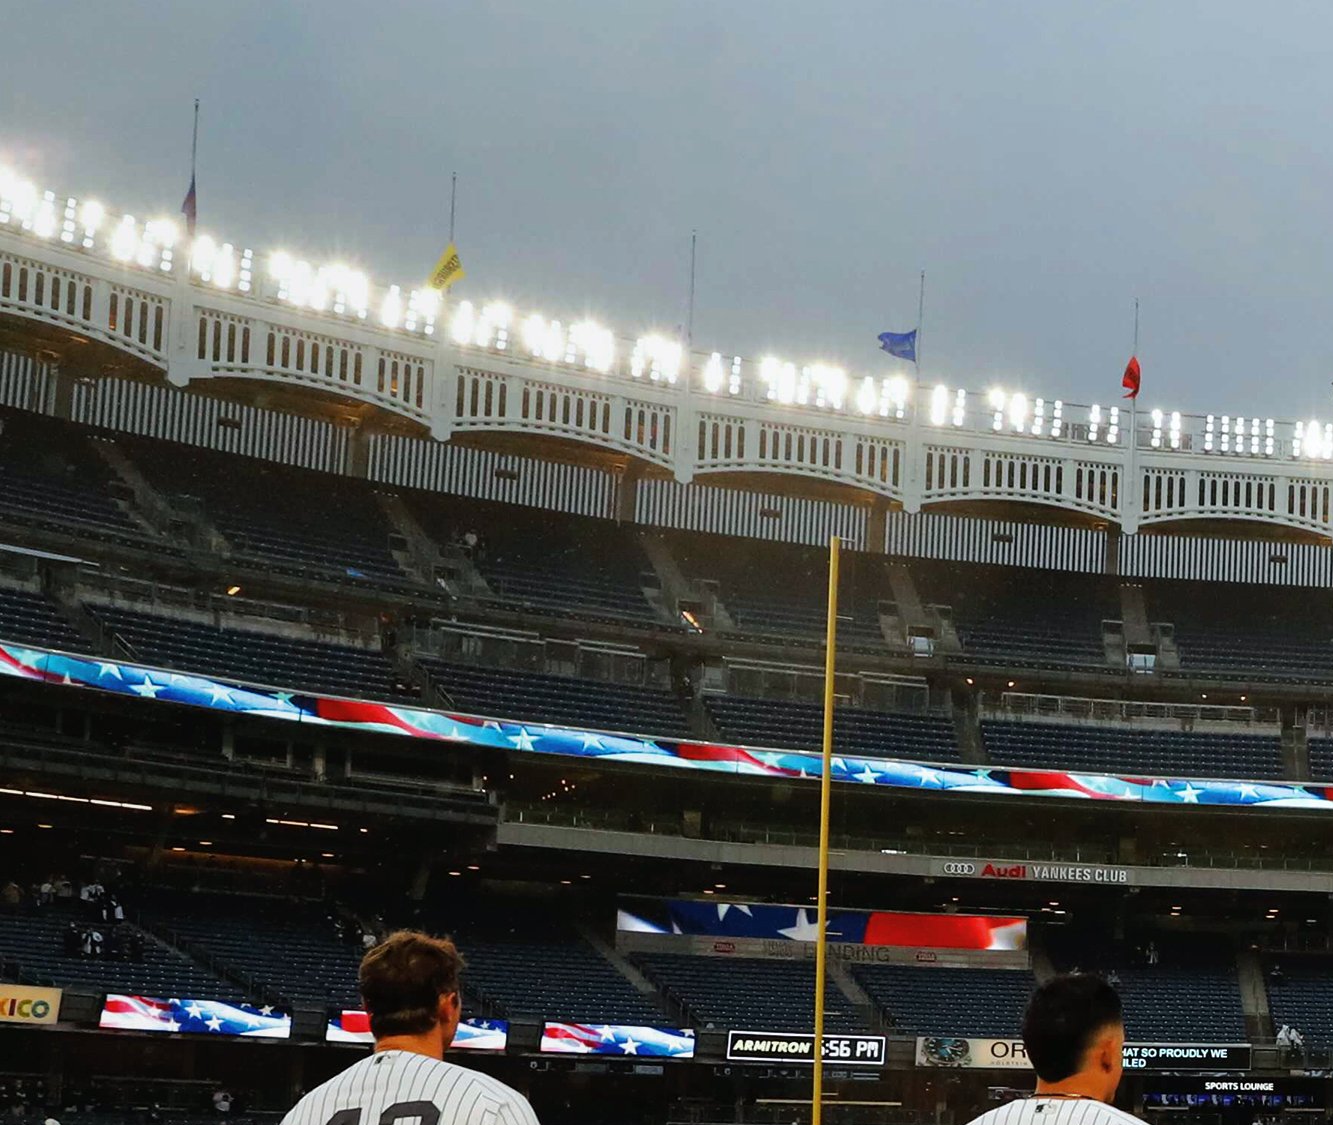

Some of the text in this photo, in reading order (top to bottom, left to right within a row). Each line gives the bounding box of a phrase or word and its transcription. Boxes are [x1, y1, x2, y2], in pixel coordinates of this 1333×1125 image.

[981, 863, 1127, 883] Audi YANKEES CLUB
[803, 943, 890, 962] LNDING
[733, 1039, 811, 1054] ARMITRON
[856, 1041, 878, 1058] PM
[1141, 1048, 1157, 1058] SO
[1159, 1048, 1207, 1058] PROUDLY
[1210, 1049, 1228, 1059] WE
[1205, 1082, 1274, 1091] SPORTS LOUNGE
